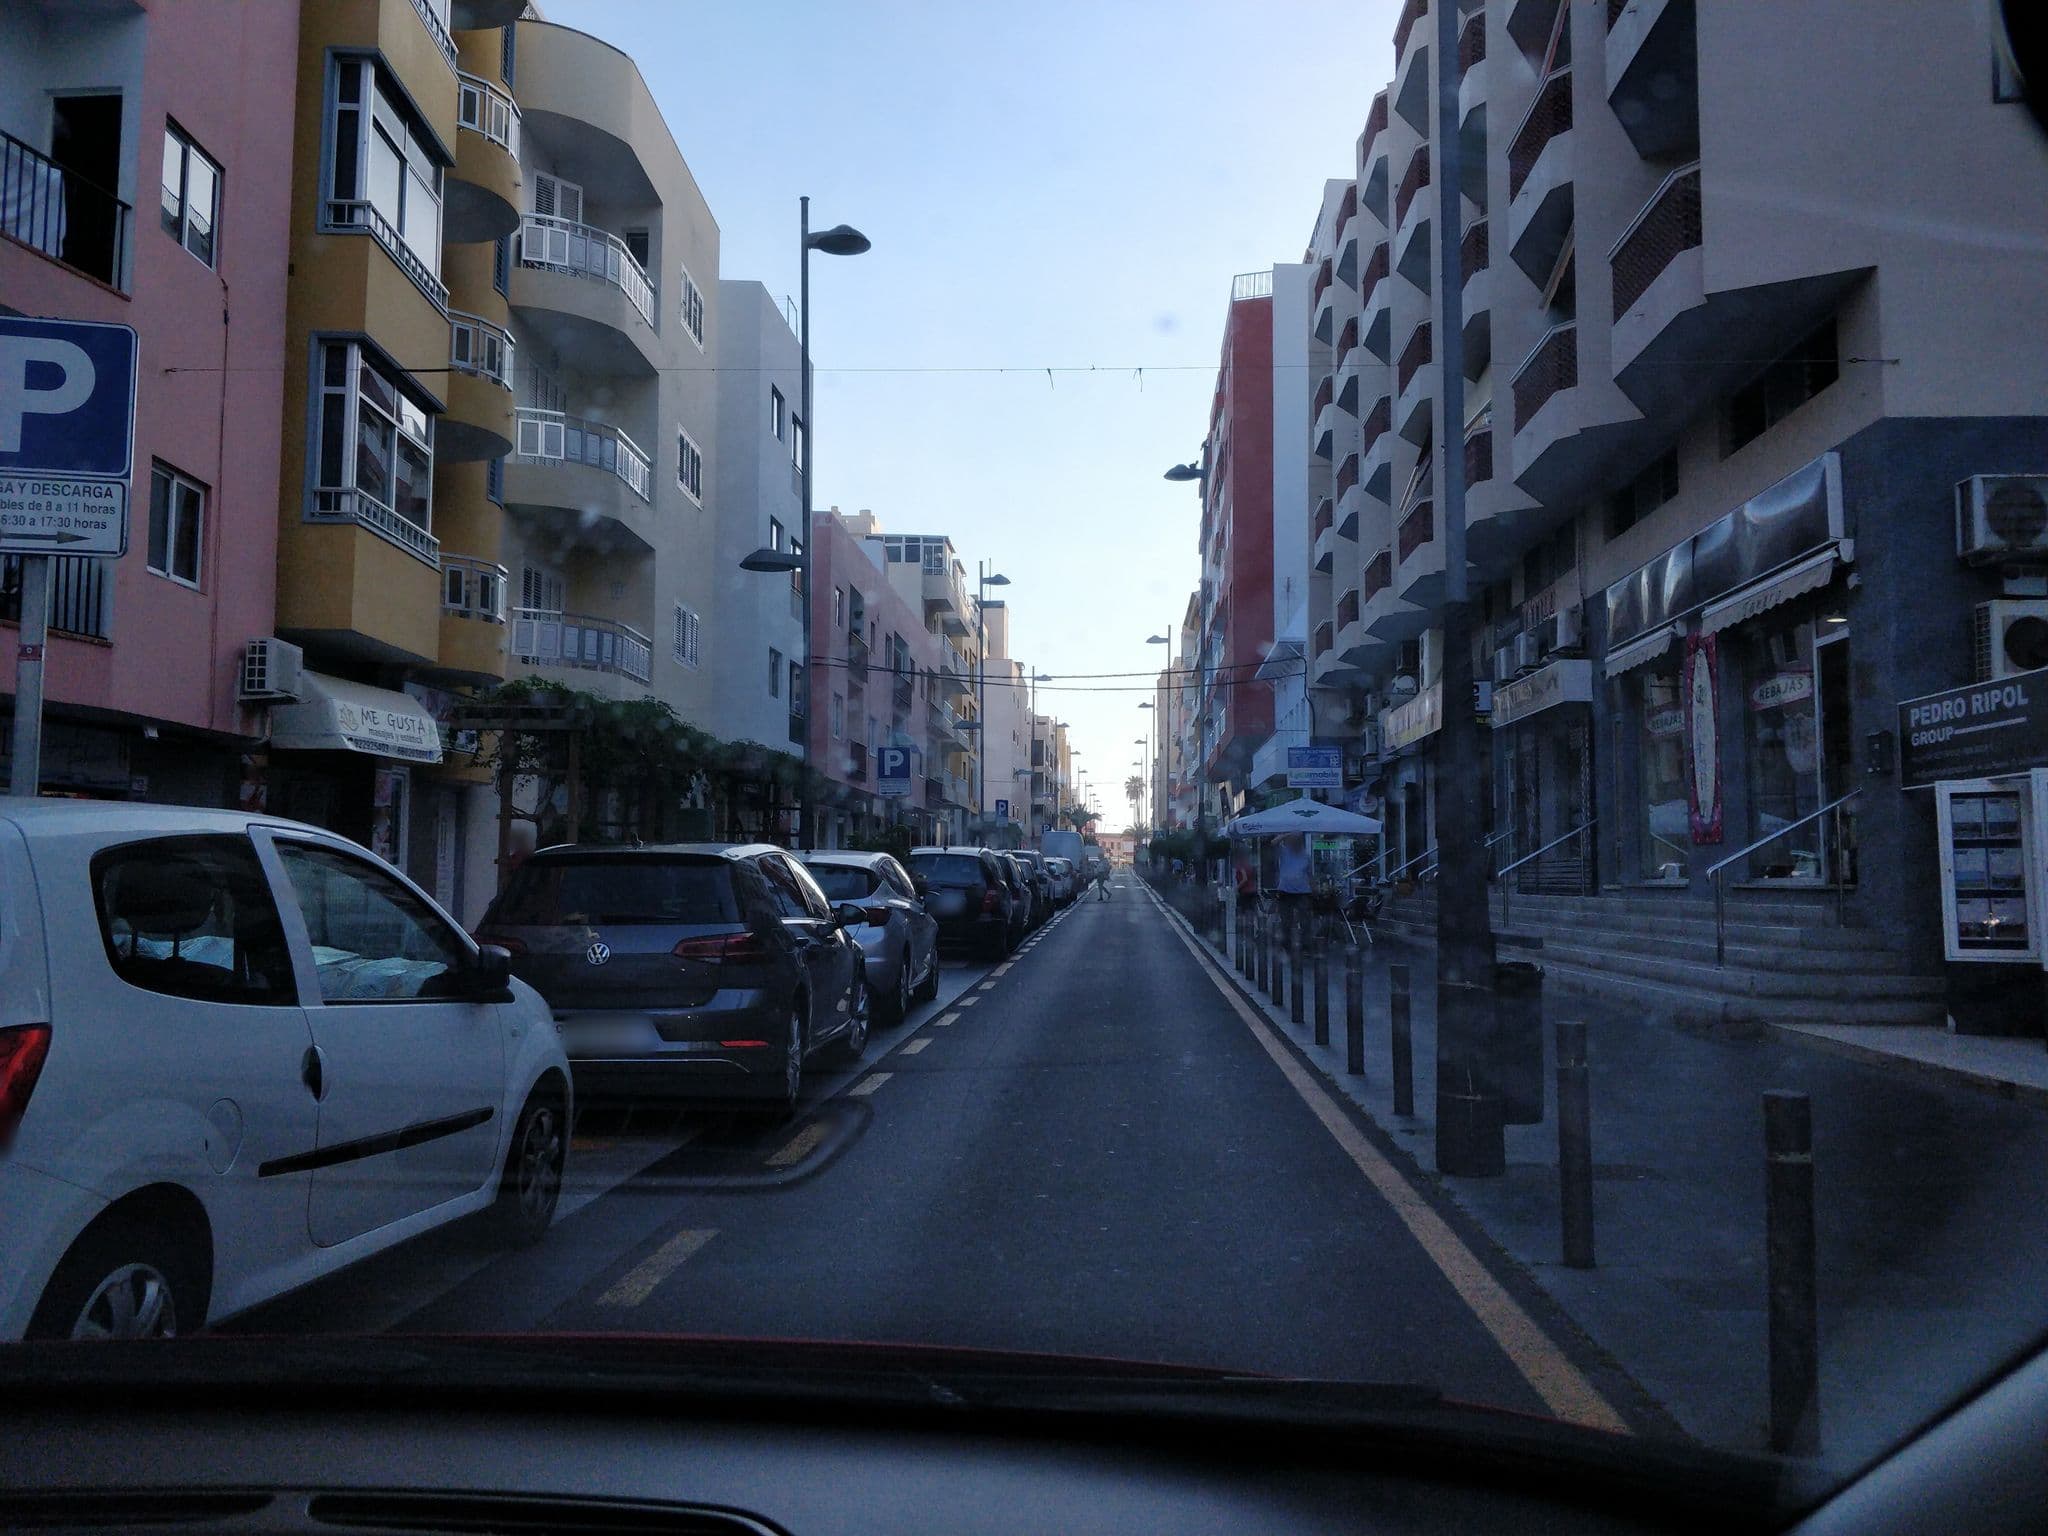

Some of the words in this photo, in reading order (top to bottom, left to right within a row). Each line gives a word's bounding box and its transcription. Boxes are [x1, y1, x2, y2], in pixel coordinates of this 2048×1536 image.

[0, 335, 96, 452] P
[18, 482, 27, 494] Y
[31, 483, 114, 499] DESCARGA
[28, 500, 43, 511] de
[45, 501, 53, 512] 8
[56, 503, 63, 512] a
[67, 502, 79, 513] 11
[83, 503, 117, 515] horas
[28, 517, 36, 526] a
[41, 516, 71, 528] 17:30
[74, 517, 108, 530] horas
[1759, 678, 1804, 701] REBAJAS
[1909, 697, 1967, 729] PEDRO
[1972, 684, 2030, 716] RIPOL
[361, 708, 379, 725] ME
[387, 714, 425, 734] GUSTA
[1911, 725, 1955, 748] GROUP
[884, 750, 904, 775] P
[998, 802, 1006, 815] P
